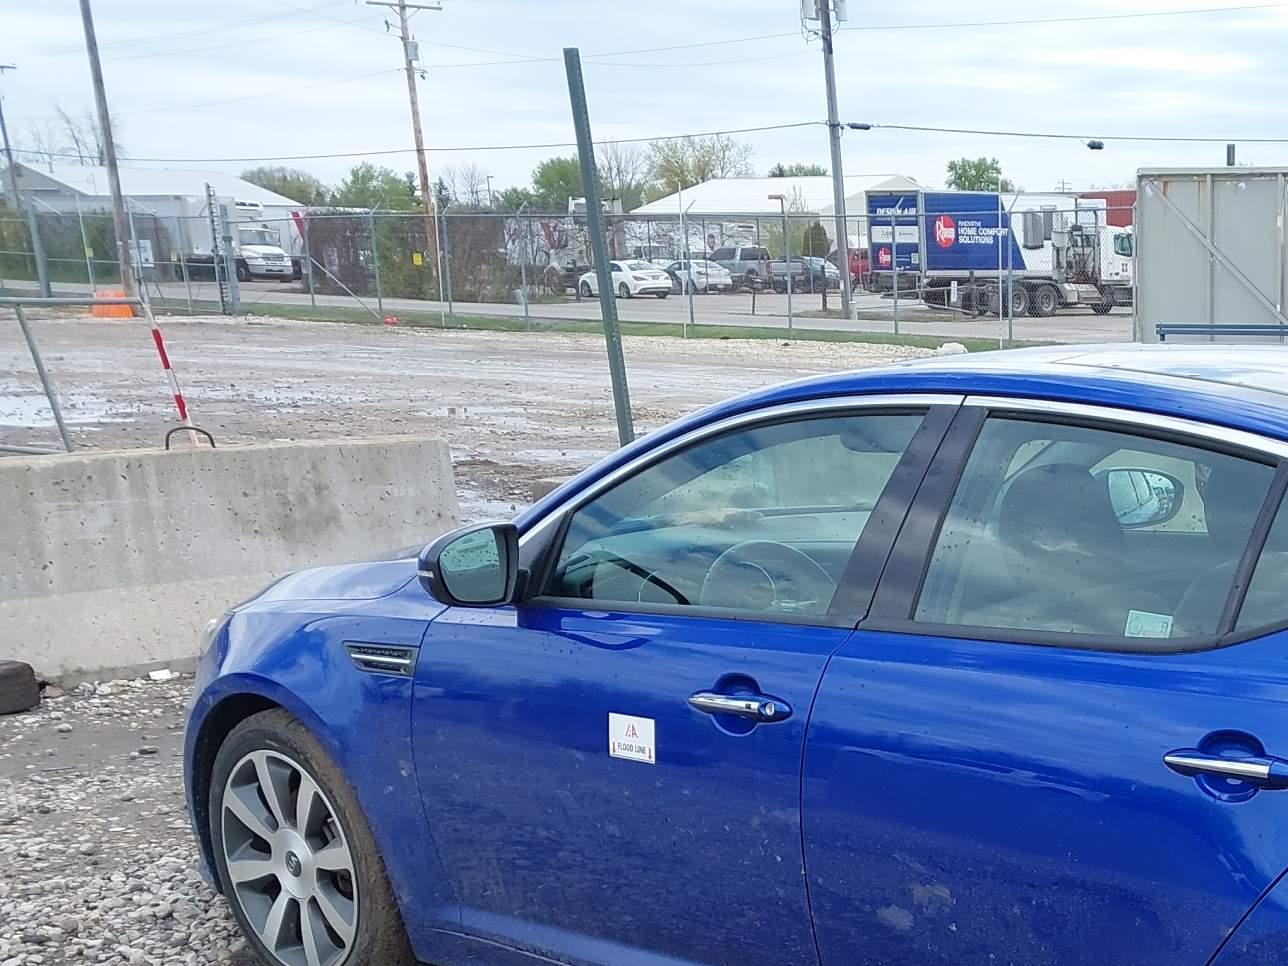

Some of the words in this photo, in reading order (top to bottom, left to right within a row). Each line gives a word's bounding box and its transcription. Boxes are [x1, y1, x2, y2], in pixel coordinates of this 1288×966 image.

[902, 207, 917, 215] AIR
[958, 228, 977, 236] HOME
[978, 227, 1009, 236] COMFORT
[958, 236, 993, 244] SOLUTIONS
[617, 743, 633, 752] FLOOD
[634, 745, 646, 754] LINE
